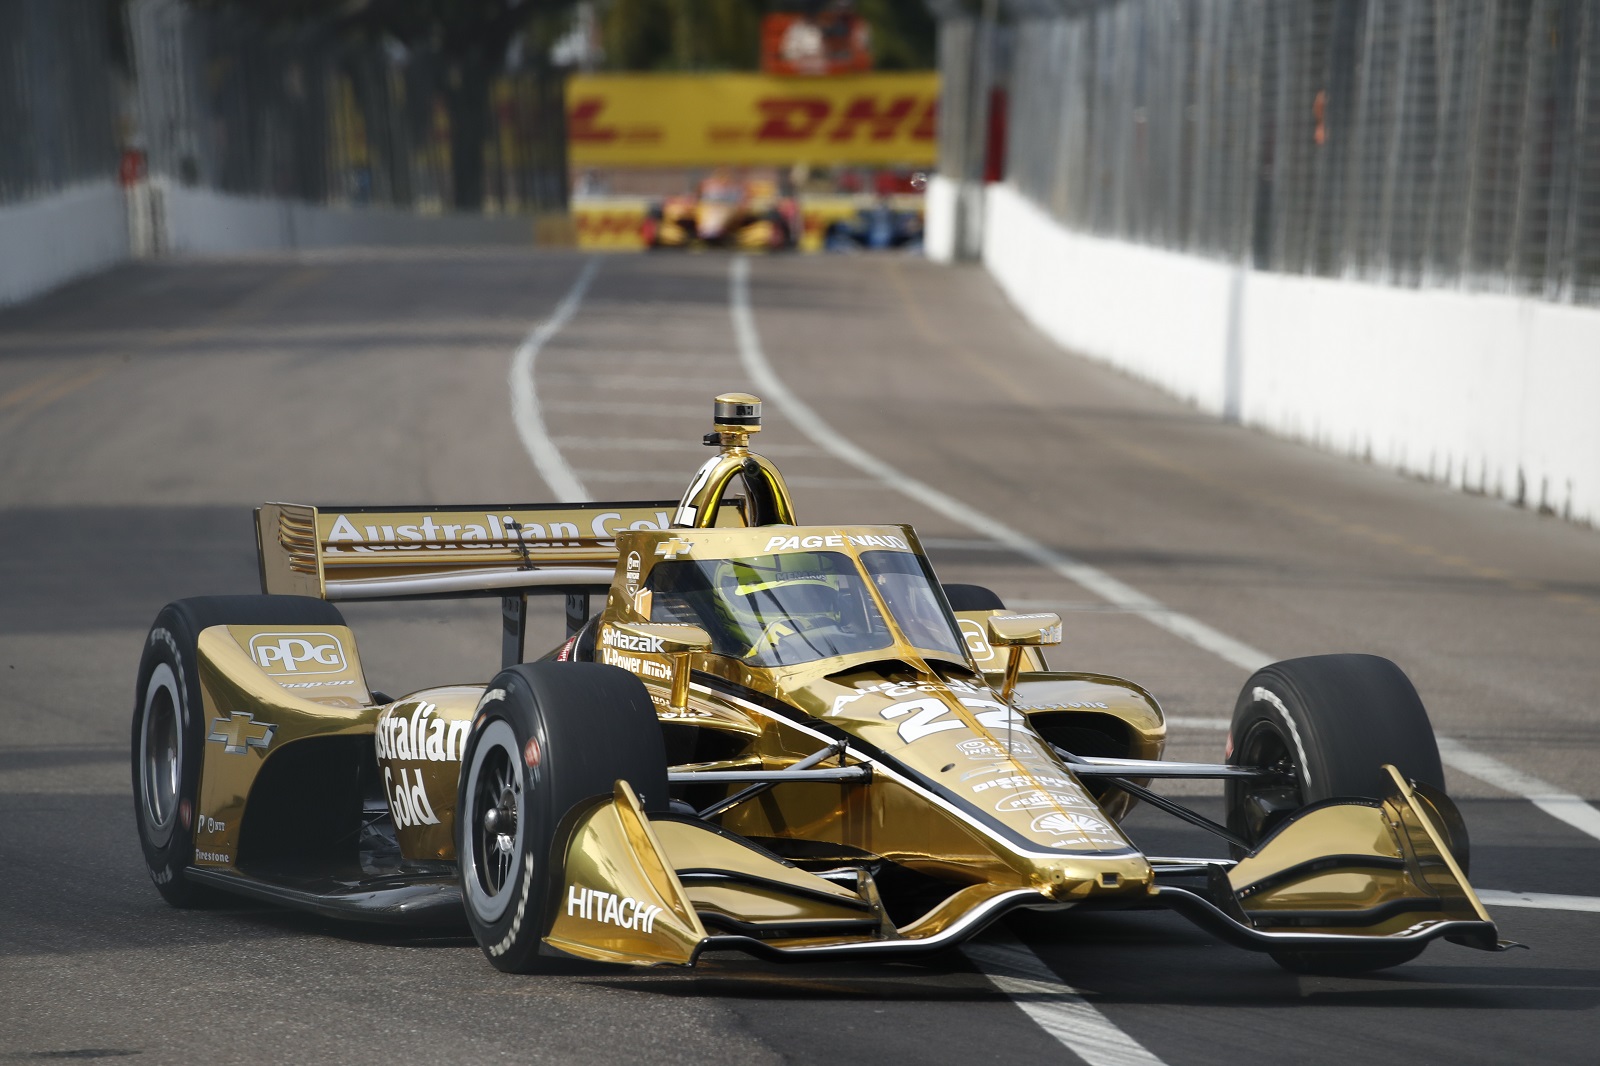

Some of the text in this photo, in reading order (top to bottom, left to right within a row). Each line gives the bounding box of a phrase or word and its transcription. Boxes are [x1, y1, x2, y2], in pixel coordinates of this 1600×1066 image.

[326, 513, 582, 552] Australian
[764, 535, 908, 552] PAGENAUD
[257, 638, 340, 671] PPG
[607, 628, 666, 653] Mazak
[385, 766, 442, 830] Gold
[195, 848, 230, 863] Firestone
[567, 885, 664, 934] HITACHI
